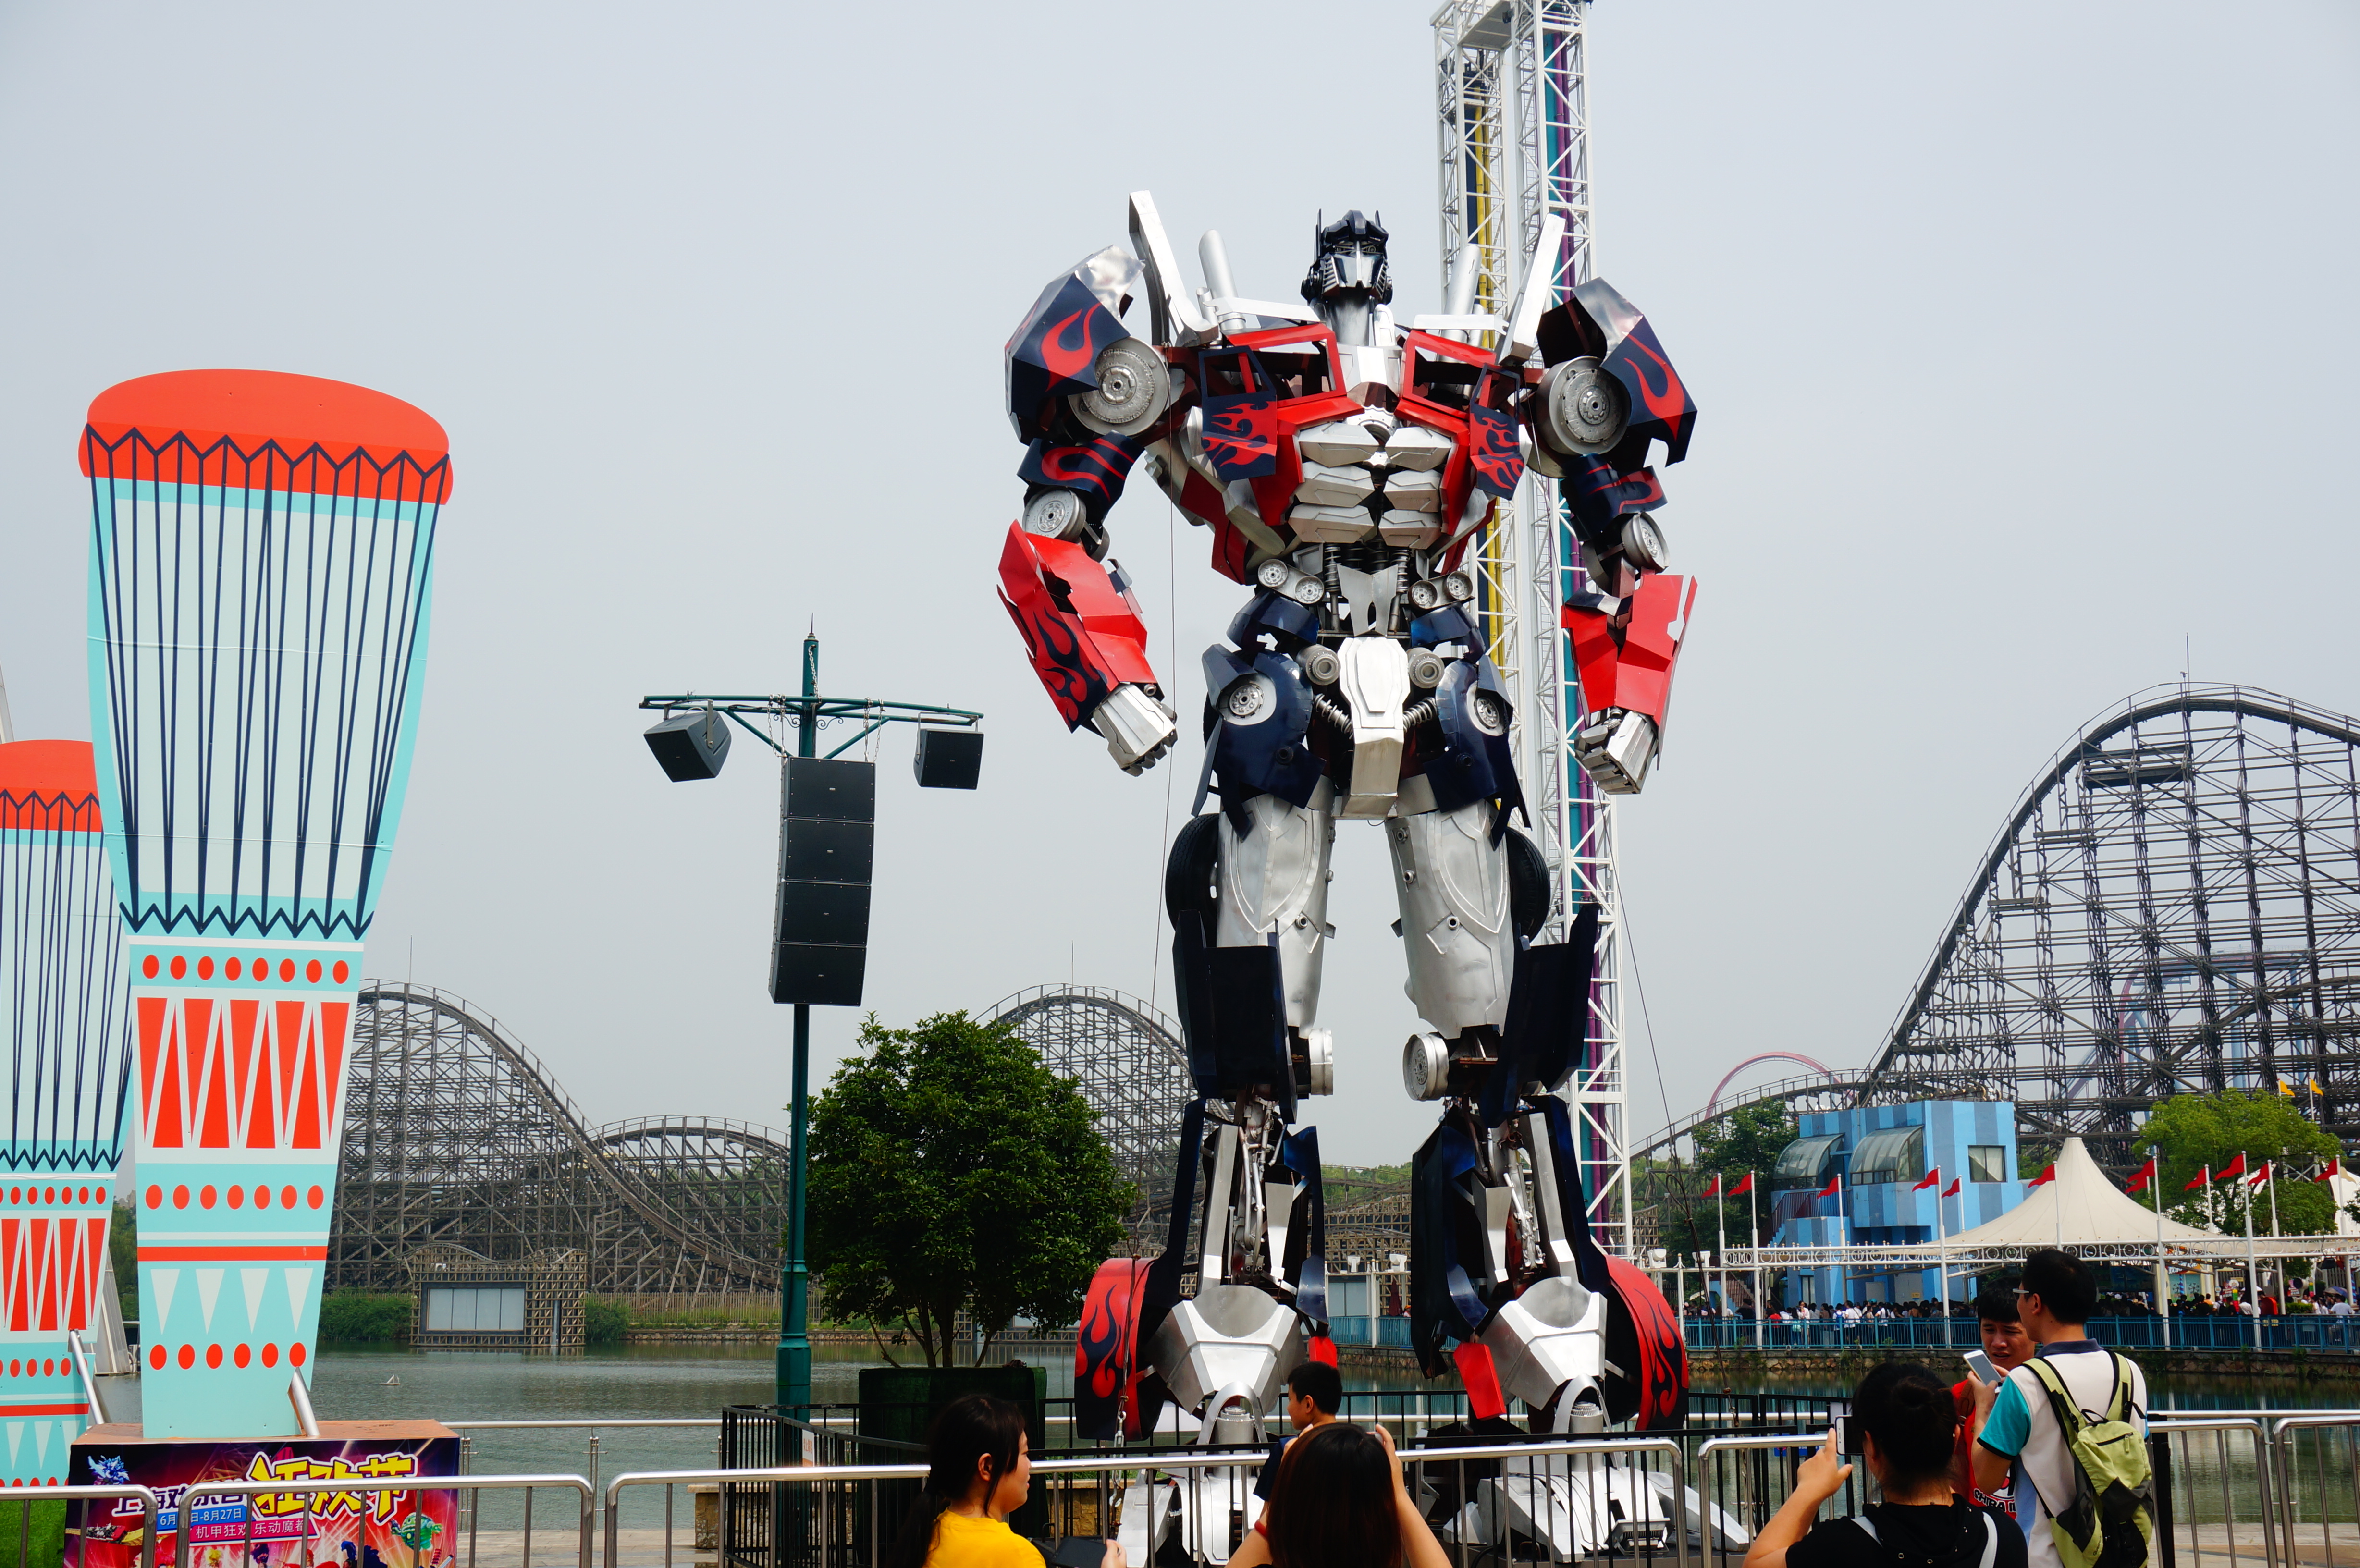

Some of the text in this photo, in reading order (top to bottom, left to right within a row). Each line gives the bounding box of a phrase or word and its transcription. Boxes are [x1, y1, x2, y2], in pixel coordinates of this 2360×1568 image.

[248, 1454, 416, 1523] 狂欢节
[160, 1508, 242, 1526] 6月日-8月27日
[196, 1523, 246, 1539] 机甲狂欢
